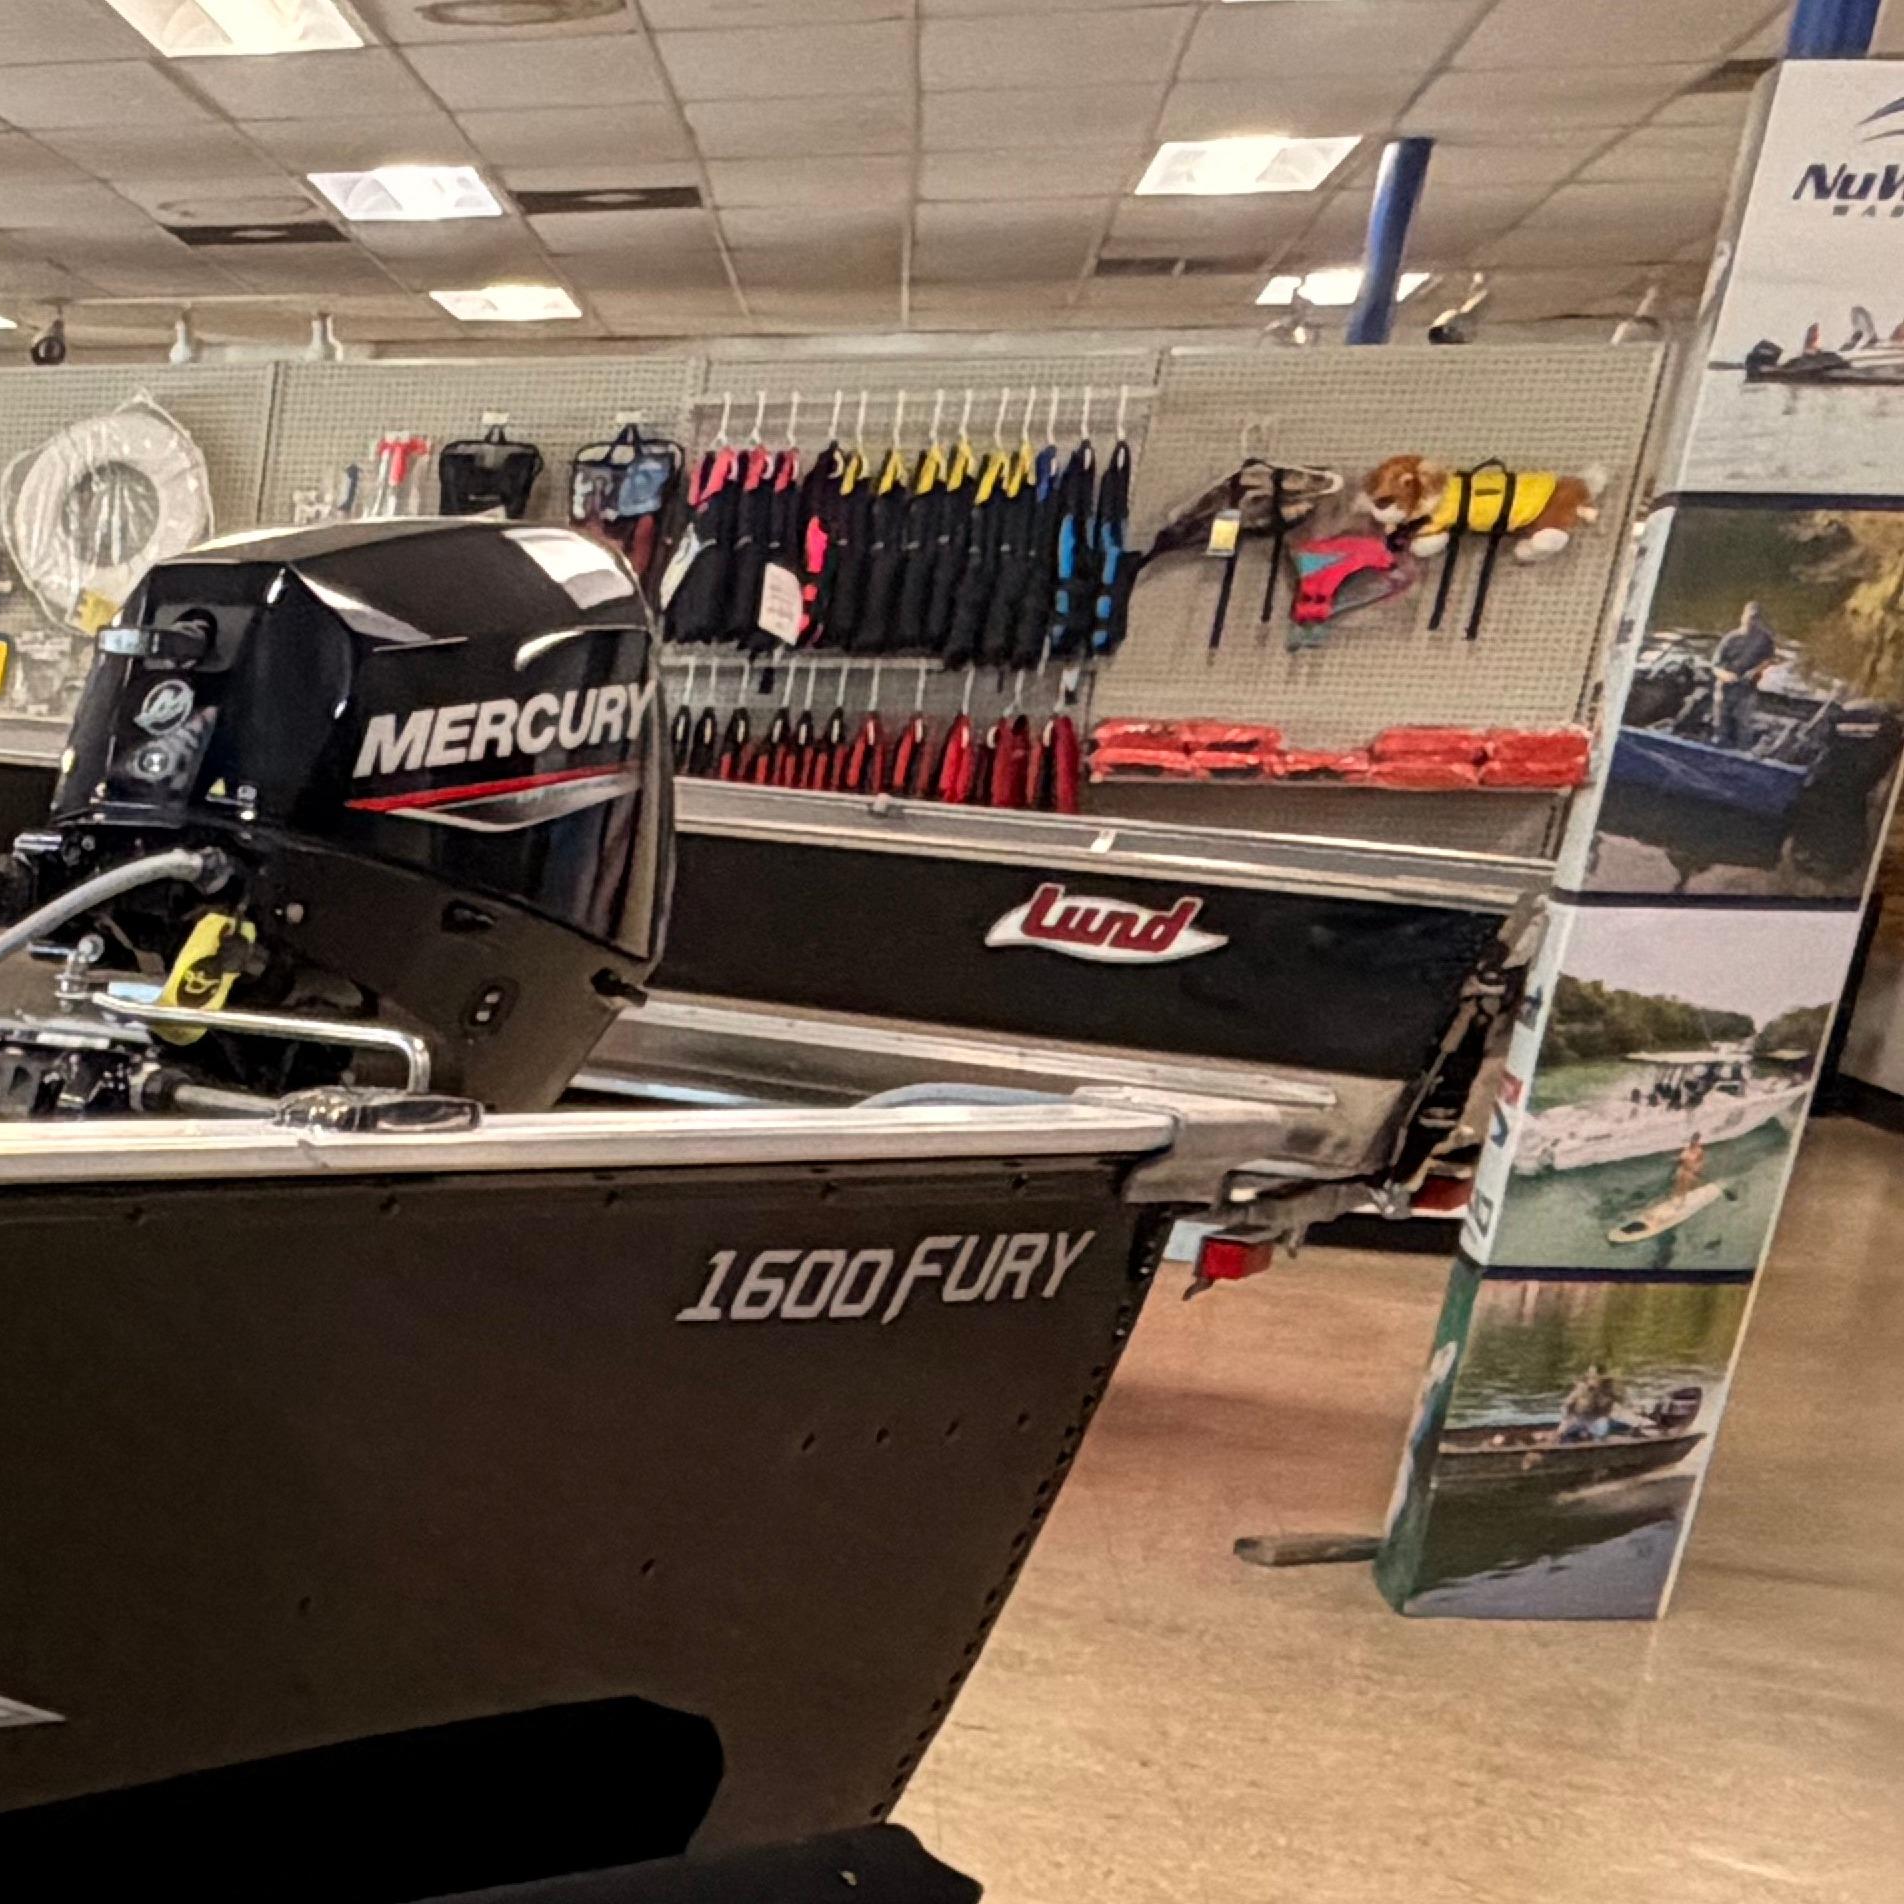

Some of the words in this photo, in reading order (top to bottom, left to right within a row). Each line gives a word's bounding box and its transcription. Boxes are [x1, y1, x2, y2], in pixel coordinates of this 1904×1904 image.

[352, 680, 657, 779] MERCURY
[1020, 882, 1204, 954] Lund
[675, 1249, 896, 1322] 1600
[881, 1230, 1096, 1325] FURY
